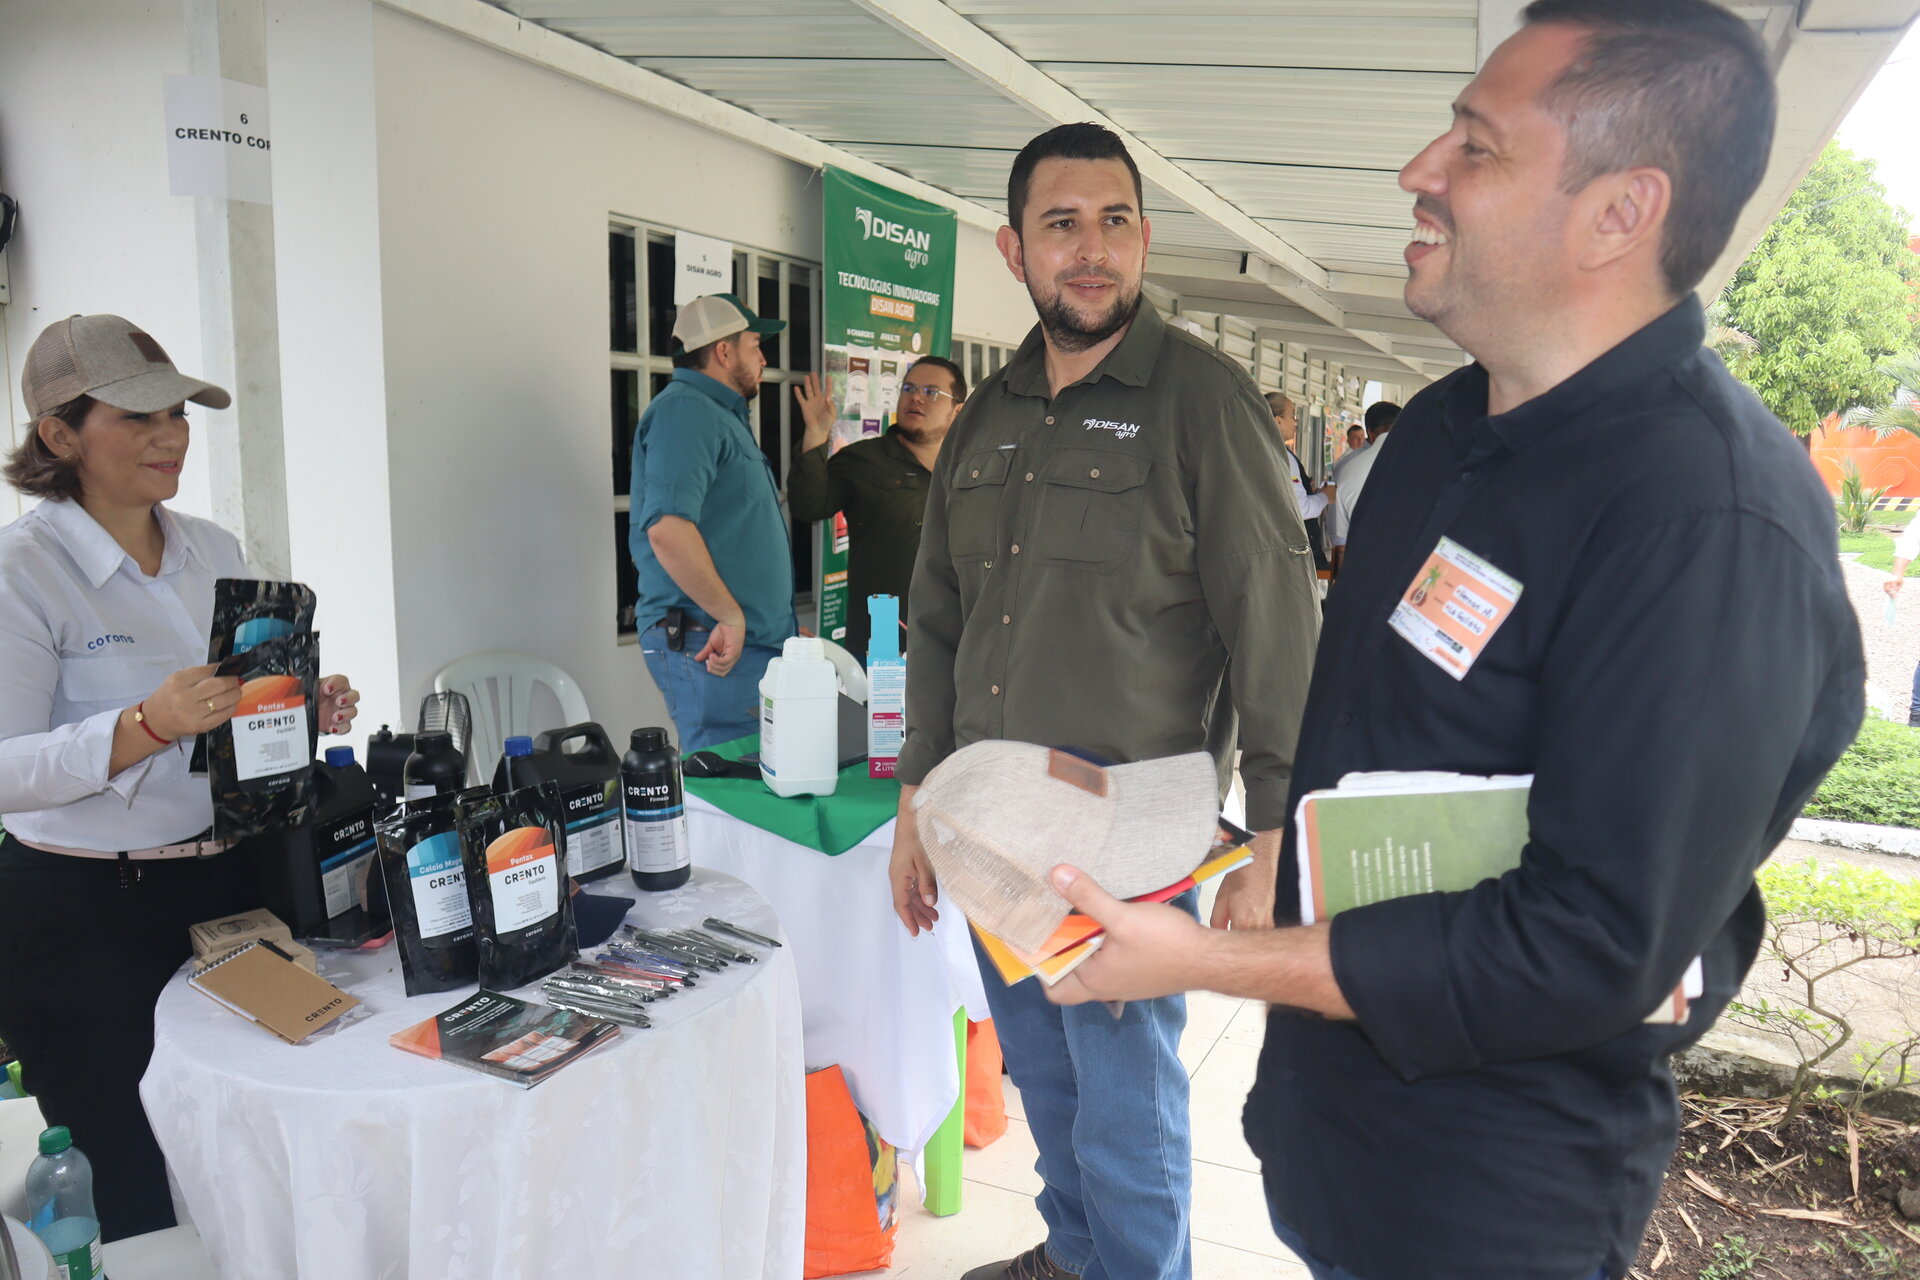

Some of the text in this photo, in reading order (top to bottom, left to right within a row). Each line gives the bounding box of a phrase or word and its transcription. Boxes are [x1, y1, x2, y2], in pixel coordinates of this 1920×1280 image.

[240, 114, 248, 124] 6
[175, 128, 242, 144] CRENTO
[872, 216, 930, 251] DISAN
[904, 248, 928, 269] agro
[686, 264, 722, 278] DISAN AGRO
[892, 284, 940, 306] INNOVADORAS
[872, 298, 914, 318] DISAN AGRO
[1094, 420, 1140, 433] DISAN
[1115, 430, 1136, 440] agro
[88, 634, 135, 650] corona
[258, 702, 286, 712] Pentax
[248, 715, 296, 731] CRENTO
[874, 762, 882, 772] 2
[268, 777, 290, 787] corona
[628, 785, 669, 796] CRENTO
[569, 792, 603, 810] CRENTO
[334, 820, 365, 842] CRENTO
[510, 854, 534, 865] Pentax
[419, 863, 443, 874] Calcio
[504, 864, 545, 885] CRENTO
[430, 871, 466, 889] CRENT
[453, 932, 474, 942] corona
[525, 927, 543, 937] corona
[305, 998, 343, 1022] CRENTO
[444, 997, 490, 1022] CRENTO
